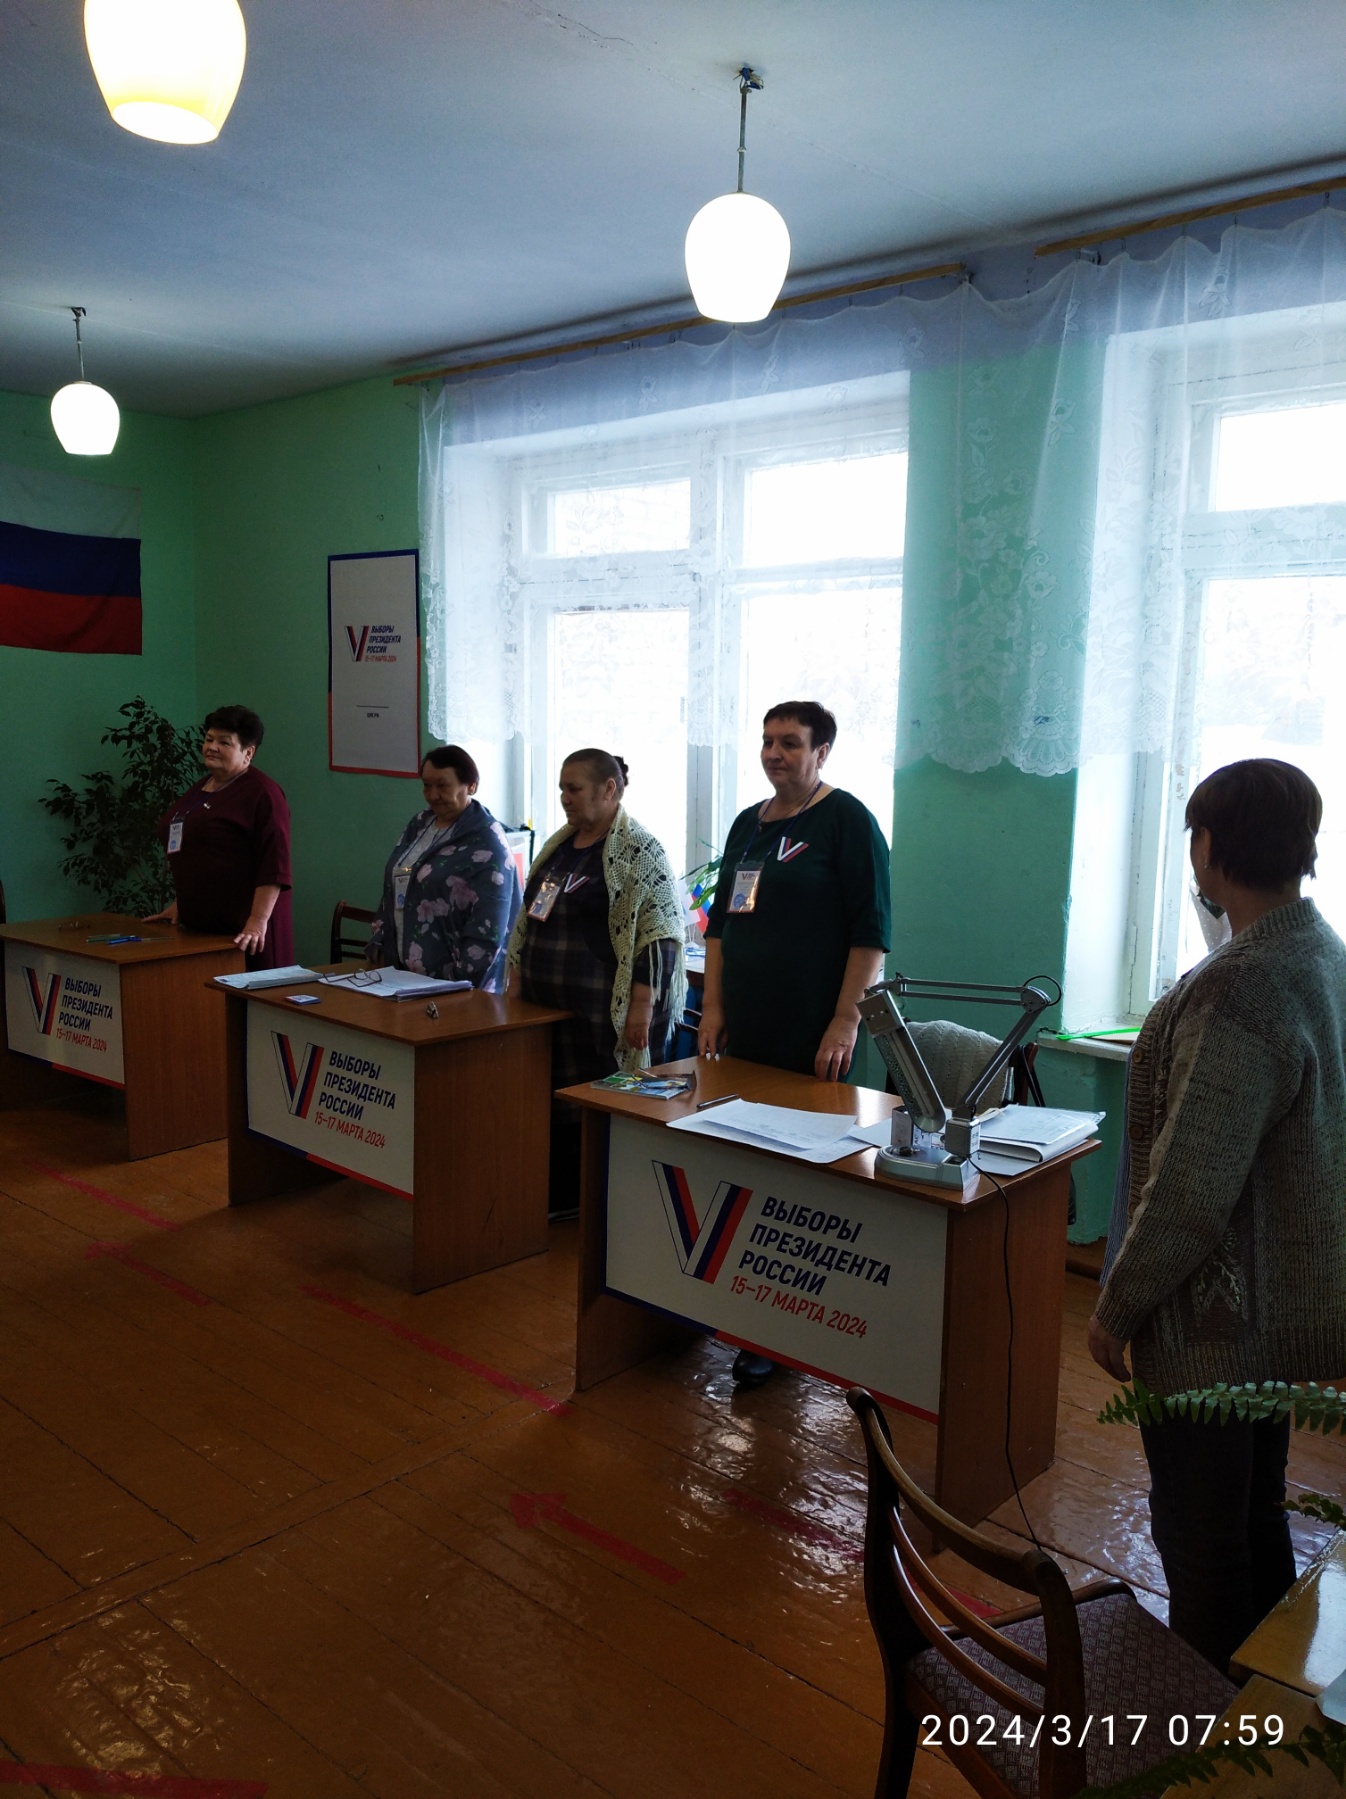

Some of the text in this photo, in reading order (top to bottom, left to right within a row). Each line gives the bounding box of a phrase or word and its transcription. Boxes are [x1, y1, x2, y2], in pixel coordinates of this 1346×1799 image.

[368, 635, 402, 644] ПРЕЗИДЕНТА
[371, 625, 395, 633] ВЫБОРЫ
[366, 645, 387, 653] РОССИИ
[64, 977, 102, 998] ВЫБОРЫ
[61, 994, 113, 1019] ПРЕЗИДЕНТА
[58, 1012, 91, 1032] РОССИИ
[72, 1032, 92, 1048] МАРТА
[92, 1038, 108, 1052] 2024
[328, 1051, 381, 1081] ВЫБОРЫ
[323, 1071, 397, 1109] ПРЕЗИДЕНТА
[318, 1092, 364, 1121] РОССИИ
[335, 1121, 364, 1141] МАРТА
[364, 1130, 386, 1149] 2024
[760, 1196, 863, 1244] ВЫБОРЫ
[749, 1223, 892, 1287] ПРЕЗИДЕНТА
[738, 1250, 827, 1296] РОССИИ
[771, 1290, 826, 1324] МАРТА
[826, 1310, 868, 1339] 2024
